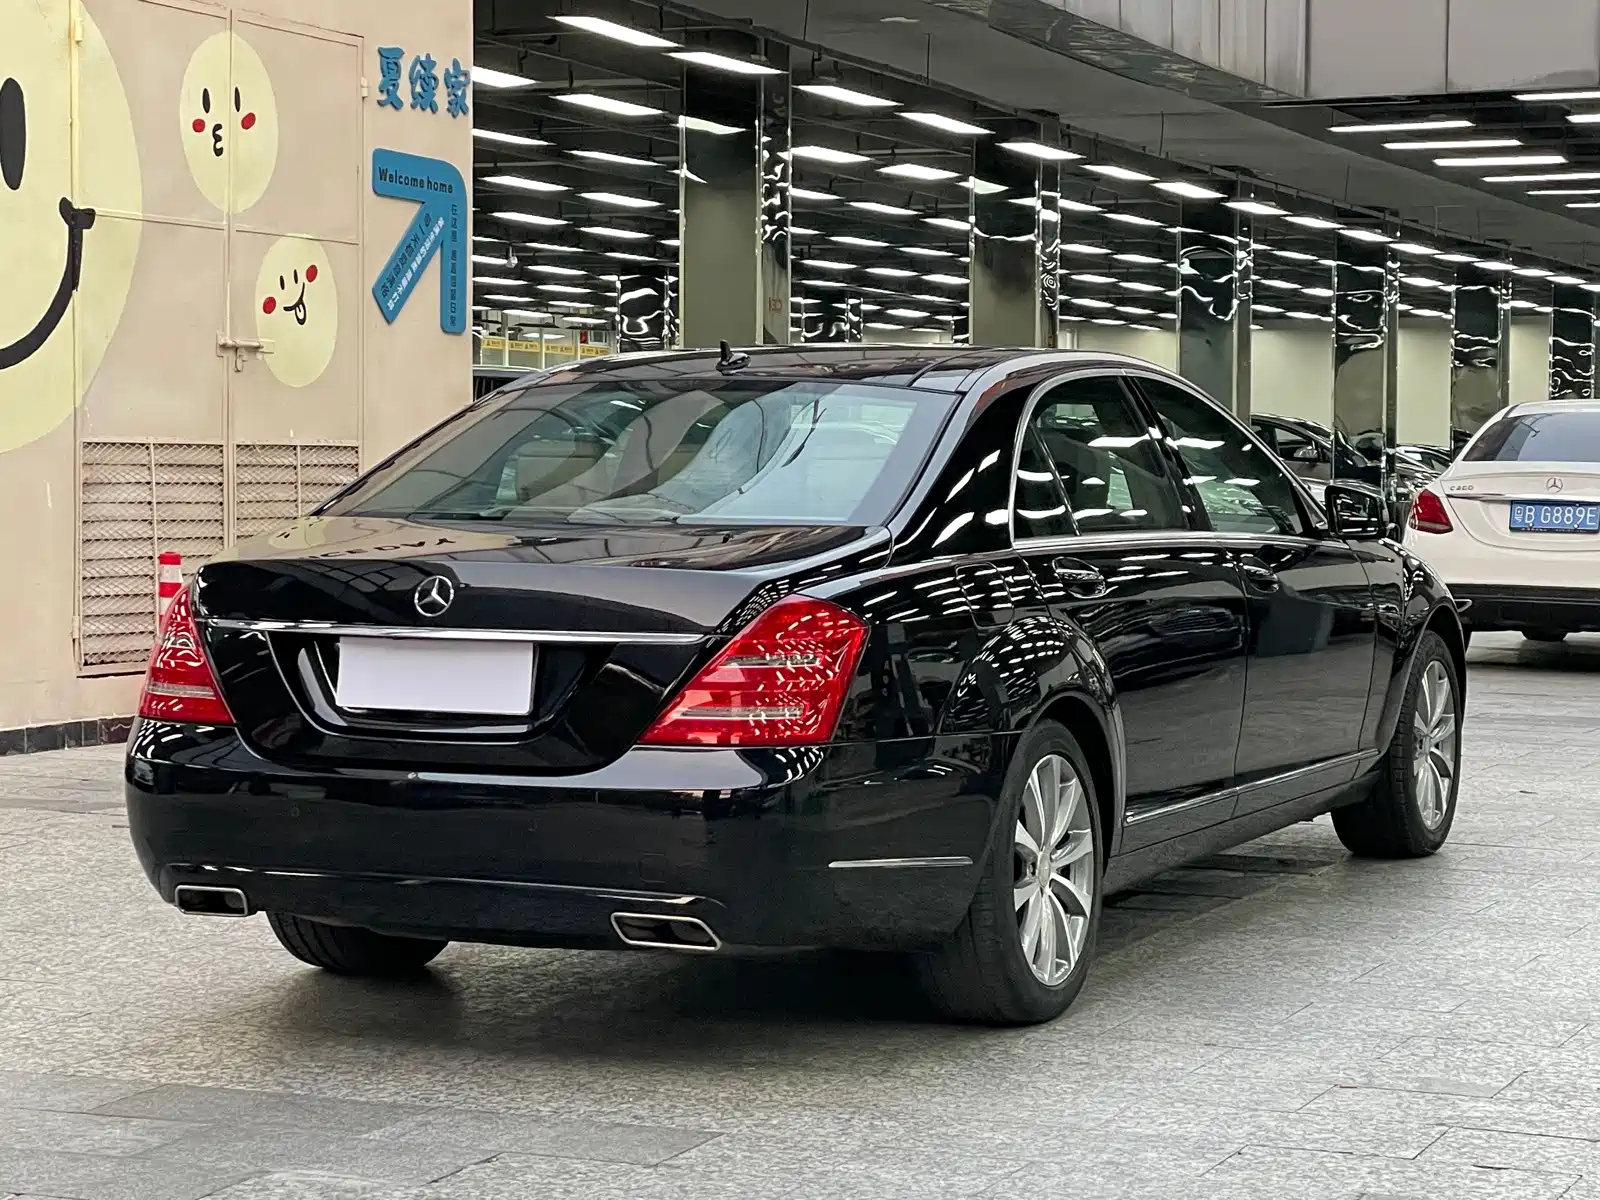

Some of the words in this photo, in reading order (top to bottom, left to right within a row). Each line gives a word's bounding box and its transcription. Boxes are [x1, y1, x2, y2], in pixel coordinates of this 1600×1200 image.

[378, 166, 425, 188] Welcome
[426, 176, 454, 194] home
[1540, 506, 1598, 525] G889E
